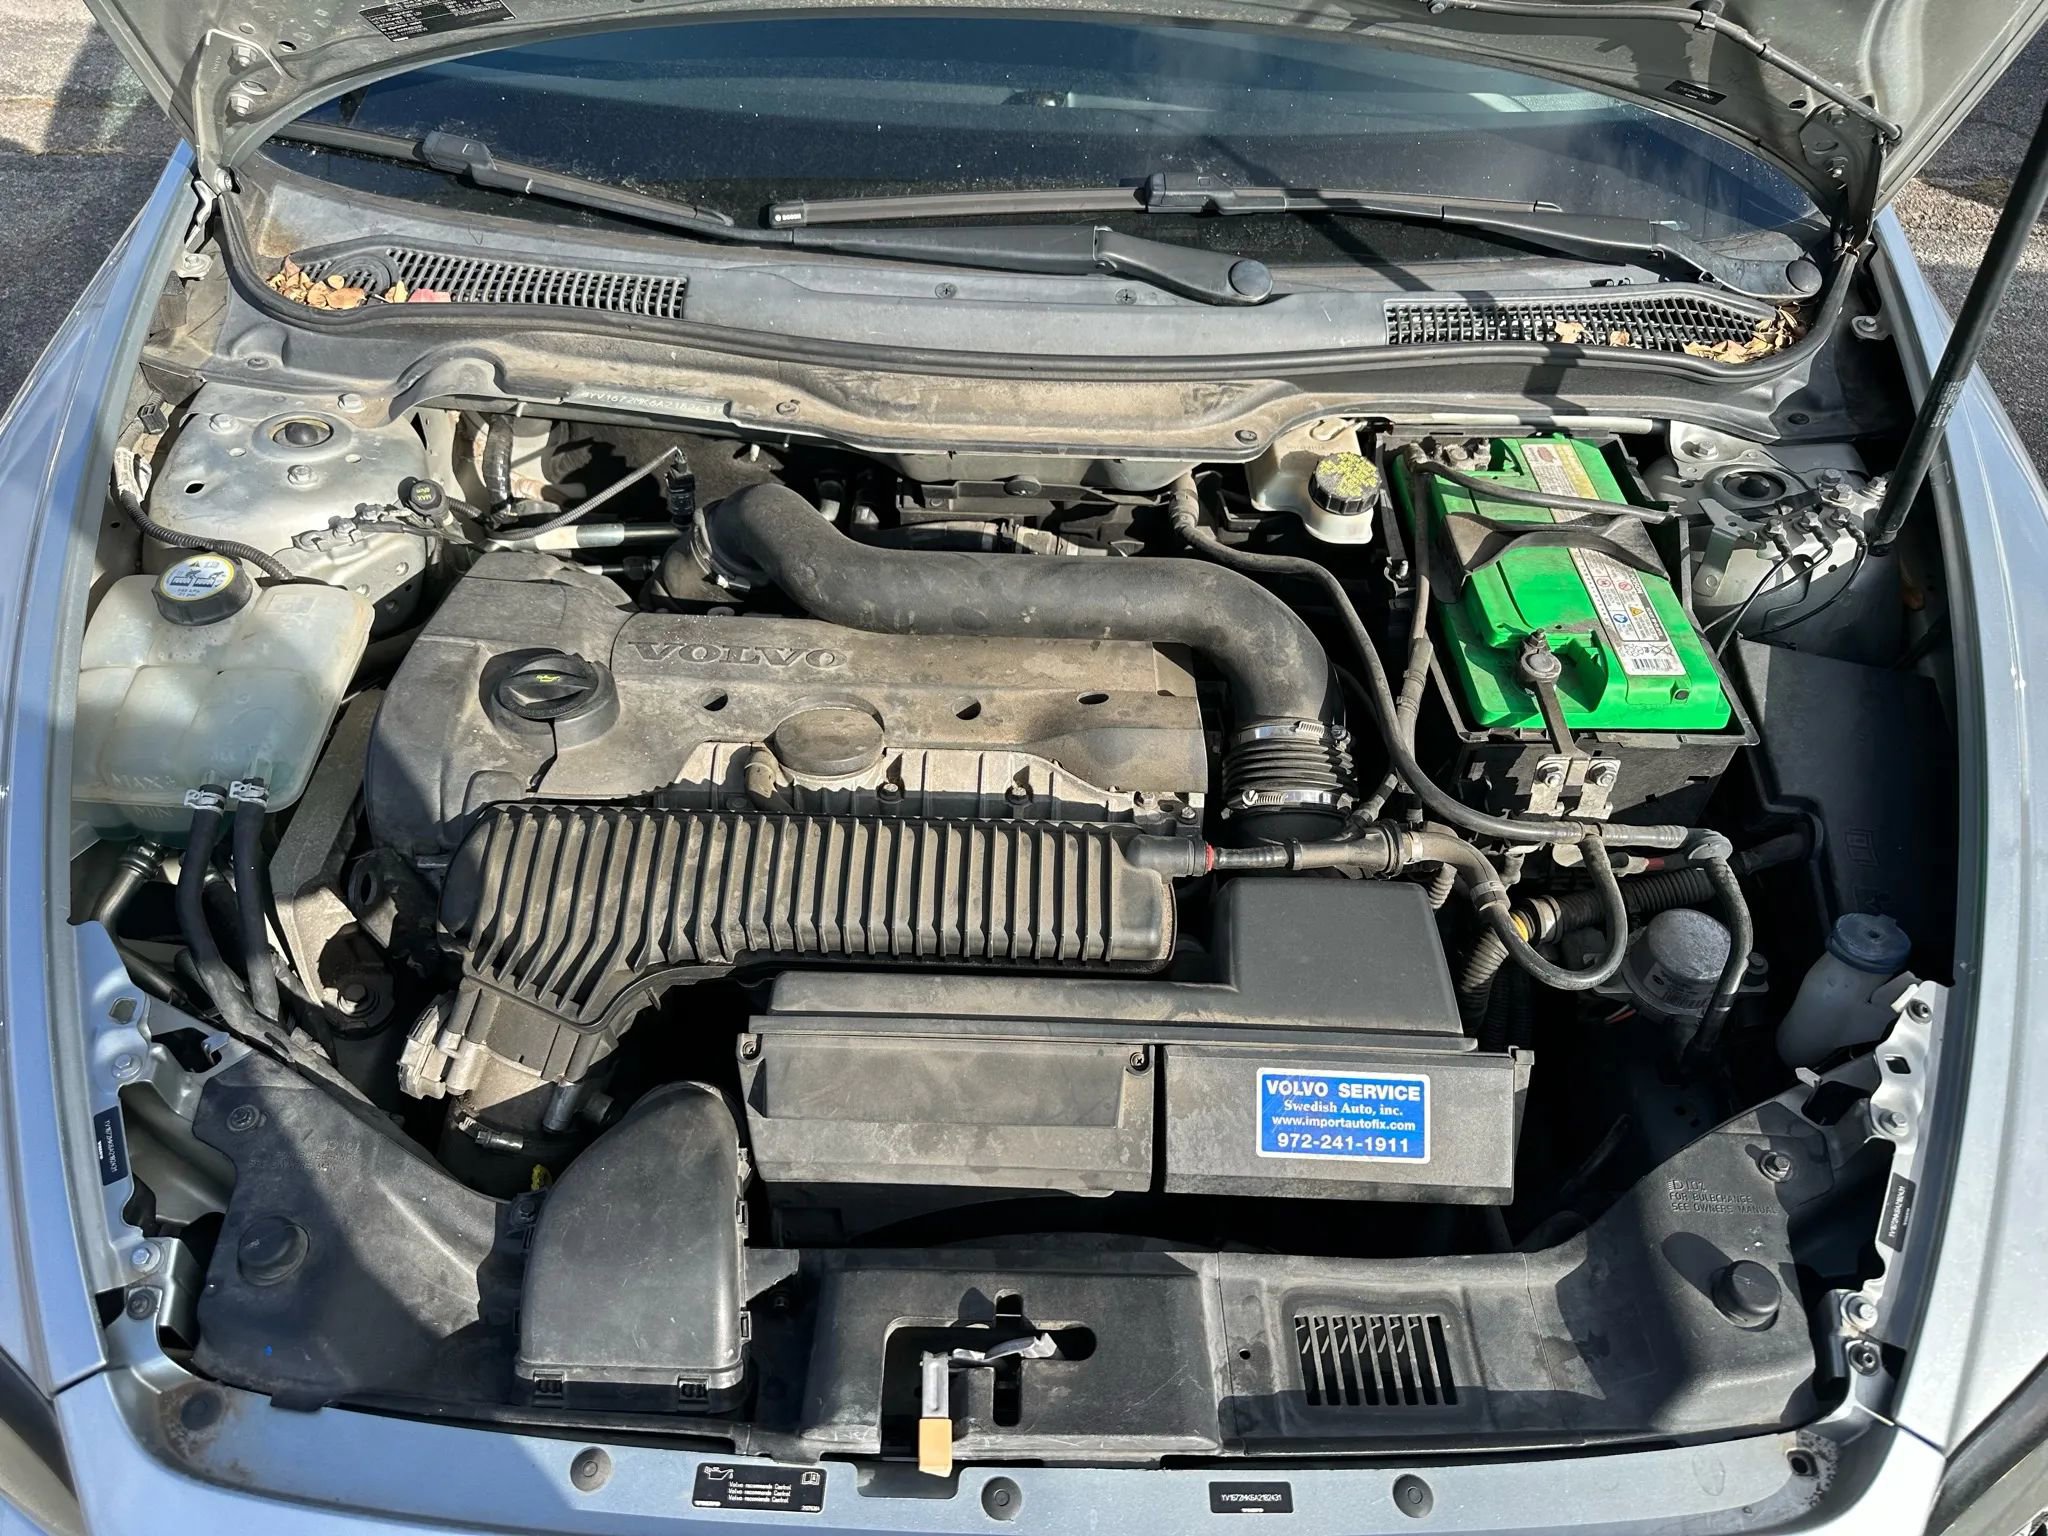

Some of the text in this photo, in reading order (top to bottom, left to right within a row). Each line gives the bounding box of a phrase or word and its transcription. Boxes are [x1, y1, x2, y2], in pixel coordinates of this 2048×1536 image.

[628, 642, 848, 669] VOLVO
[1266, 1079, 1421, 1101] VOLVO SERVICE
[1284, 1100, 1403, 1116] Swedish Auto, inc.
[1272, 1115, 1416, 1131] www.importautofix.com
[1277, 1132, 1409, 1152] 972-241-1911
[1668, 1191, 1688, 1202] FOR
[1671, 1202, 1690, 1212] SEE
